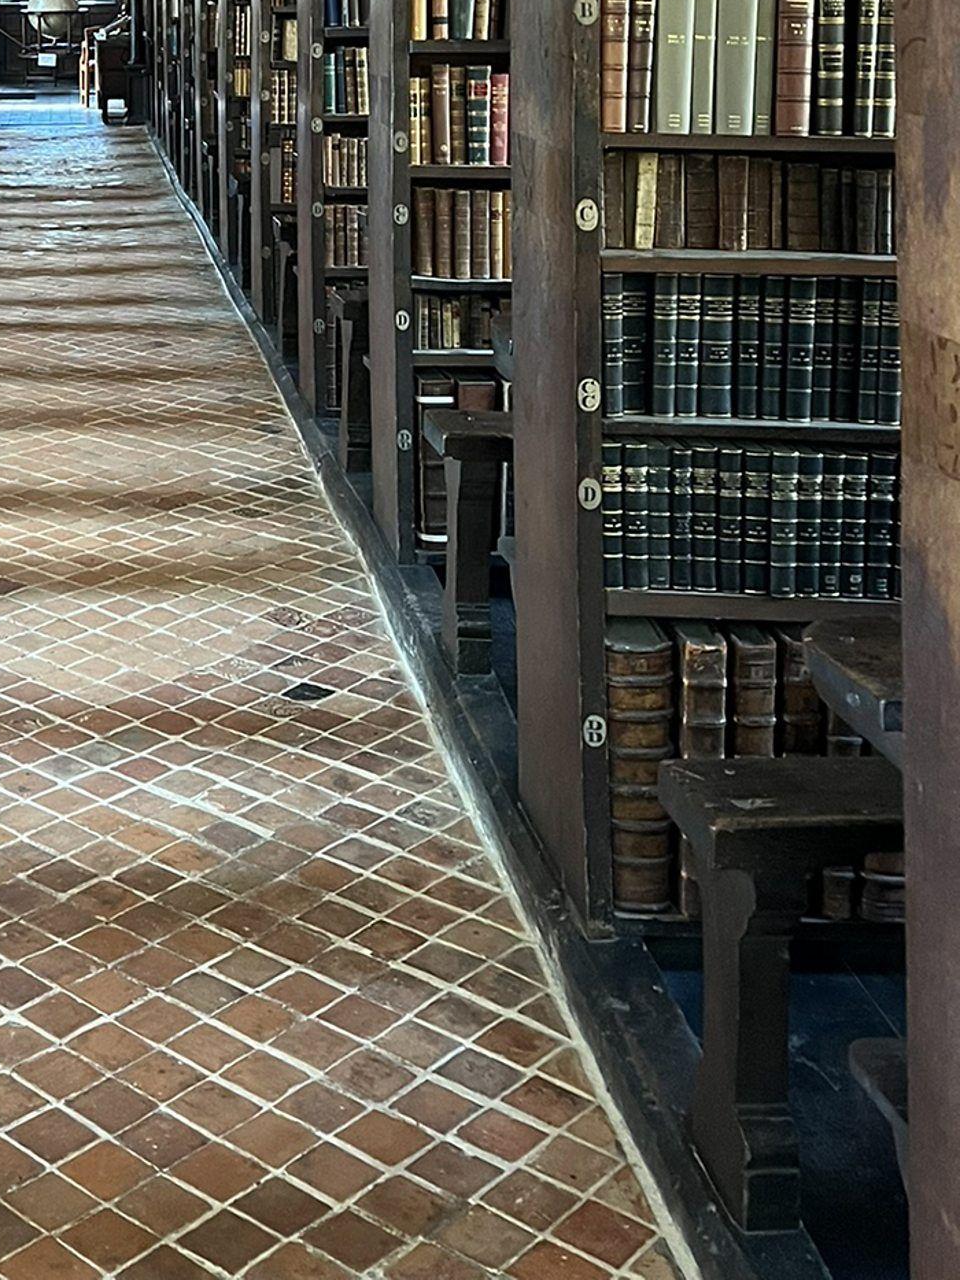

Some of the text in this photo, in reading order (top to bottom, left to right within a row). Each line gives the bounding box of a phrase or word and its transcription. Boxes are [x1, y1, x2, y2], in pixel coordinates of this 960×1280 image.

[581, 2, 593, 18] B
[580, 205, 594, 221] C
[583, 486, 596, 502] D
